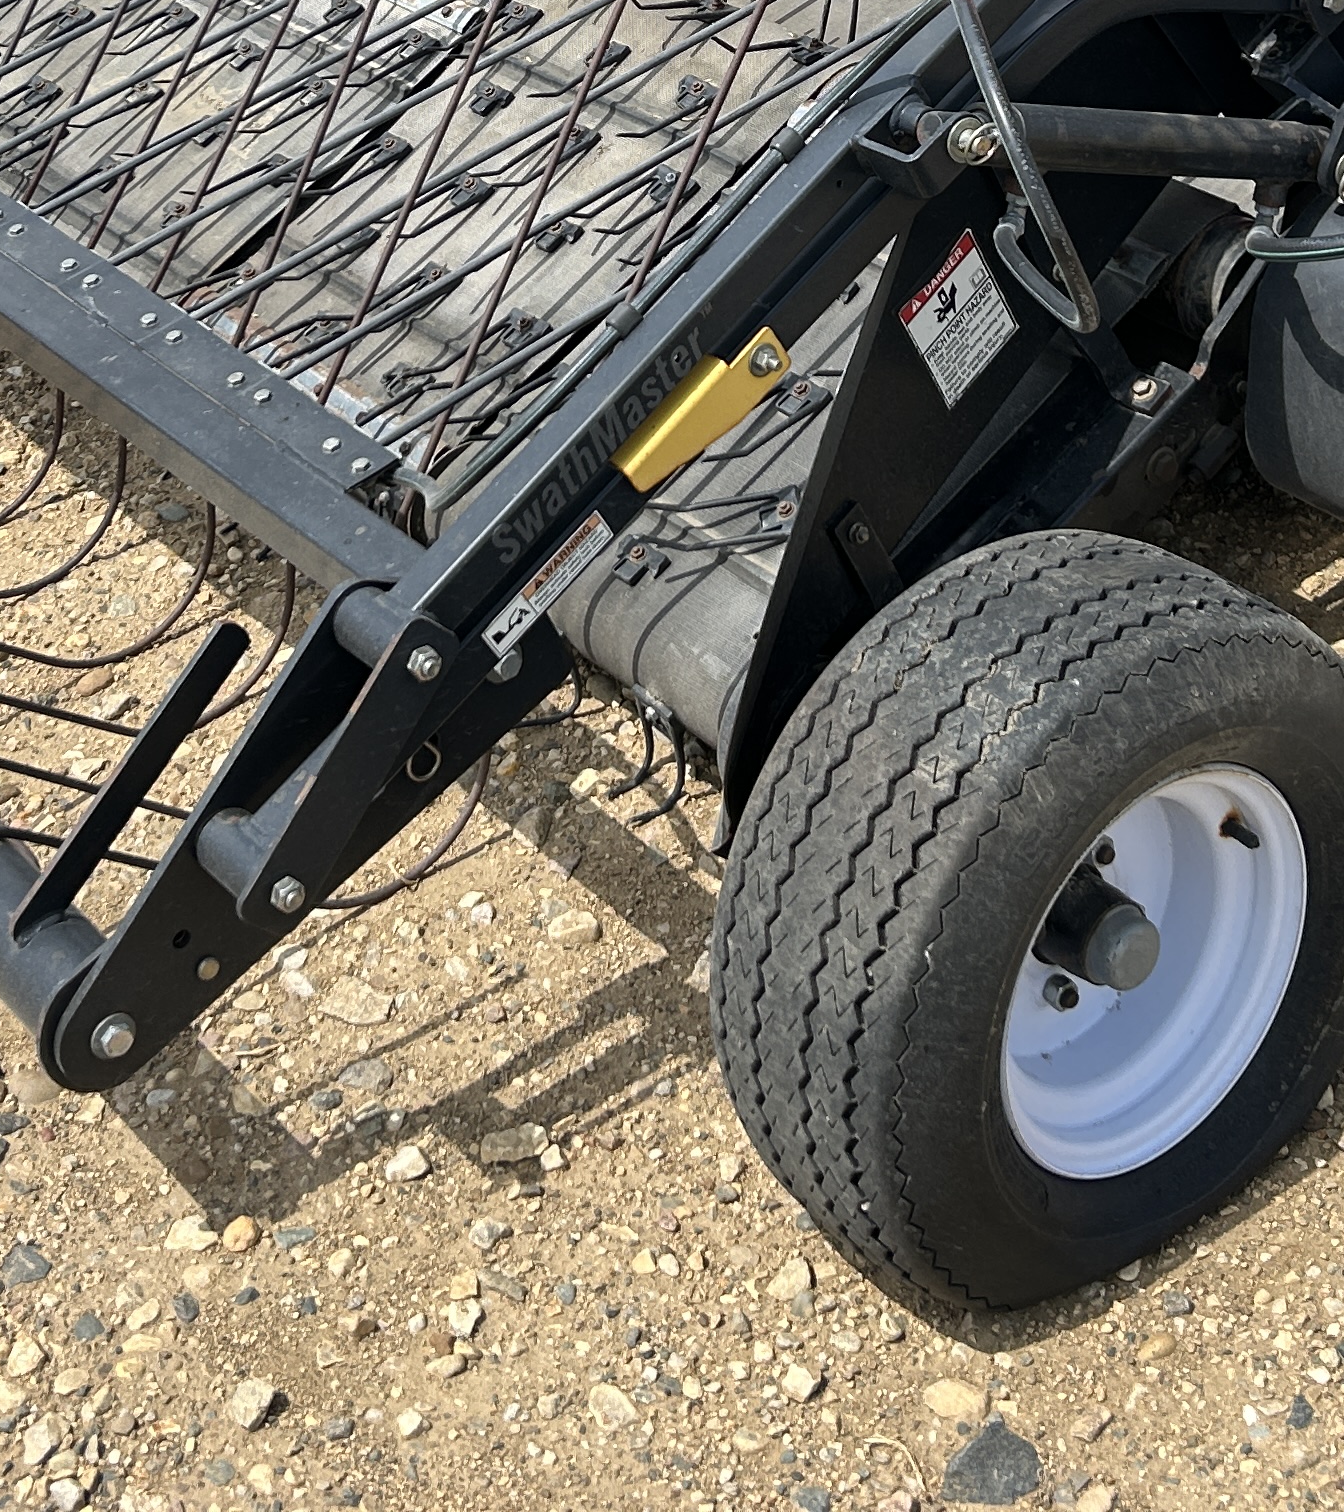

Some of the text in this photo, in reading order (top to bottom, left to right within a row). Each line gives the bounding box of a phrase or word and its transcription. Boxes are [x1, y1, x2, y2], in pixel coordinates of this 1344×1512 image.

[923, 246, 964, 298] DANGER
[925, 334, 947, 364] PINCH
[944, 310, 967, 340] POINT
[964, 279, 993, 317] HAZARD
[491, 326, 704, 564] SwathMaster
[540, 521, 593, 579] WARNING
